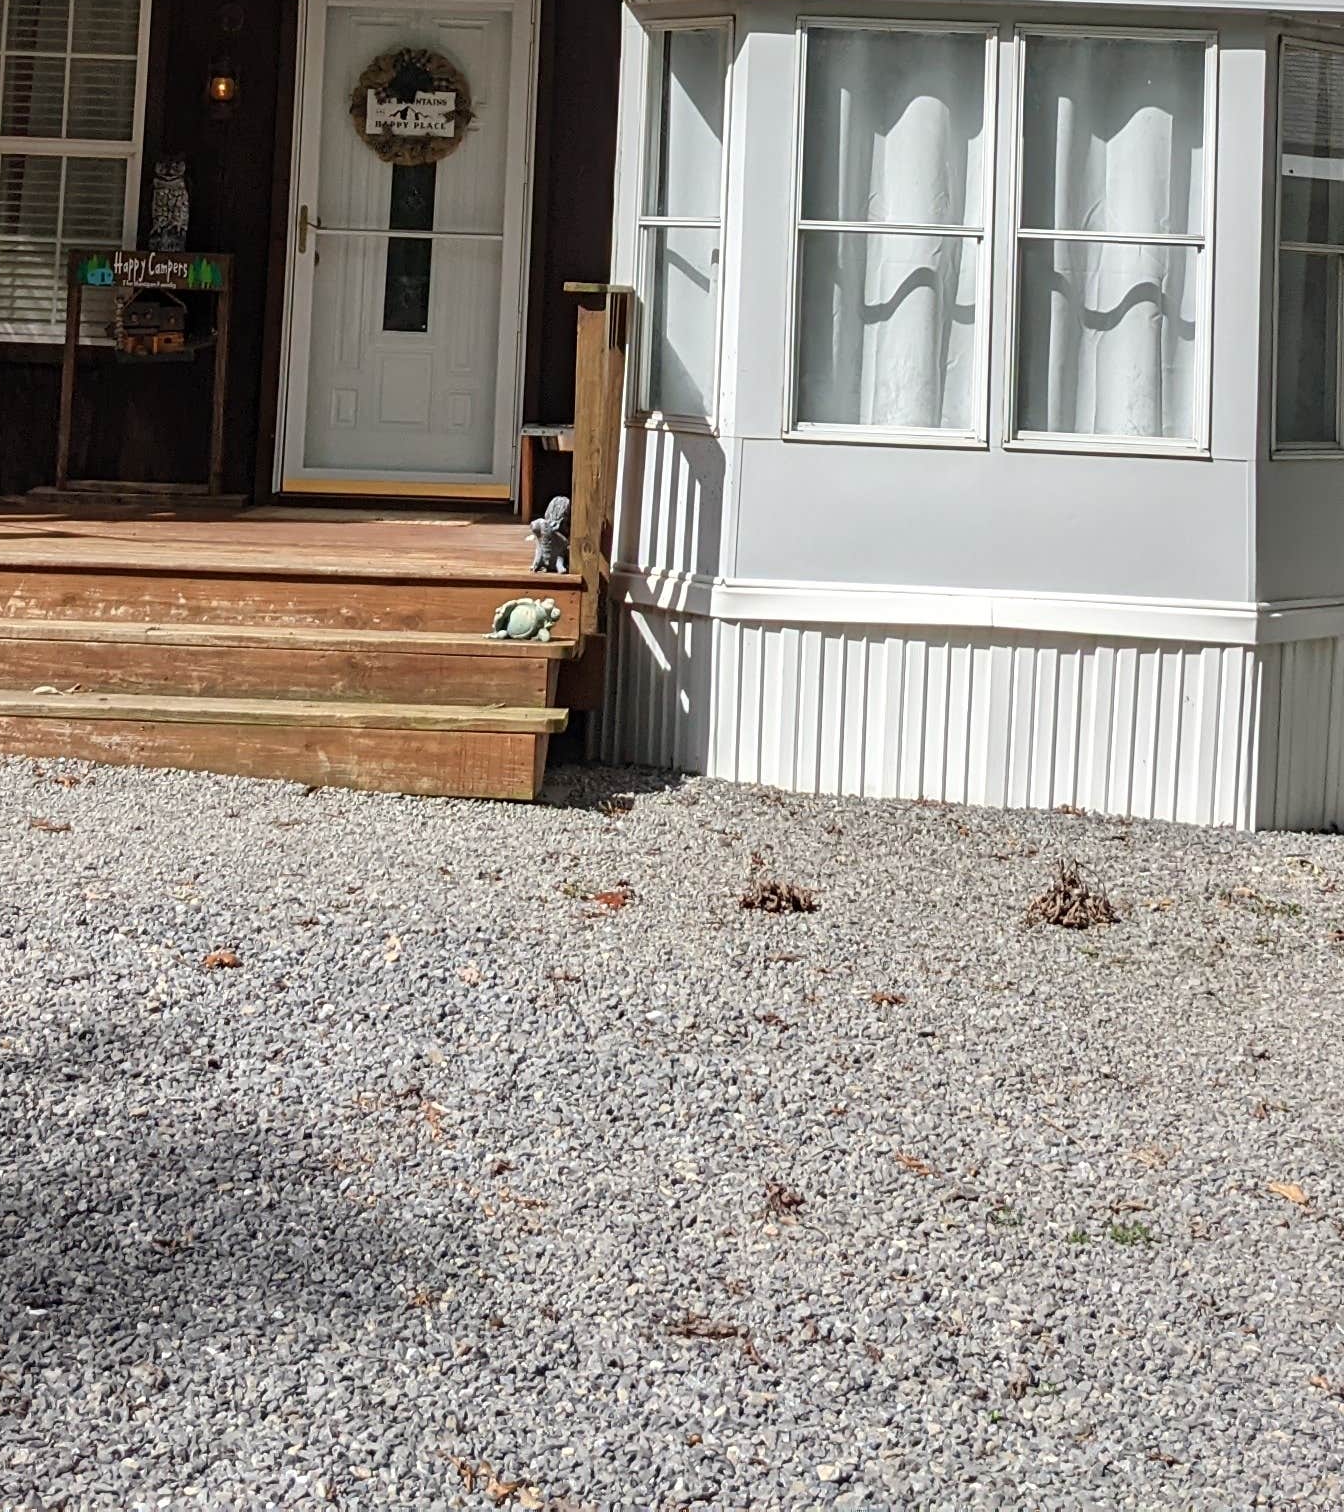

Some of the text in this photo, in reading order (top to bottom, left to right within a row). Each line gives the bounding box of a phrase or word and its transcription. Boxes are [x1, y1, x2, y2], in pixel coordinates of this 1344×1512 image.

[397, 98, 447, 106] NTAINS
[375, 121, 446, 130] HAPPY PLACE
[113, 251, 188, 283] Happy Campers
